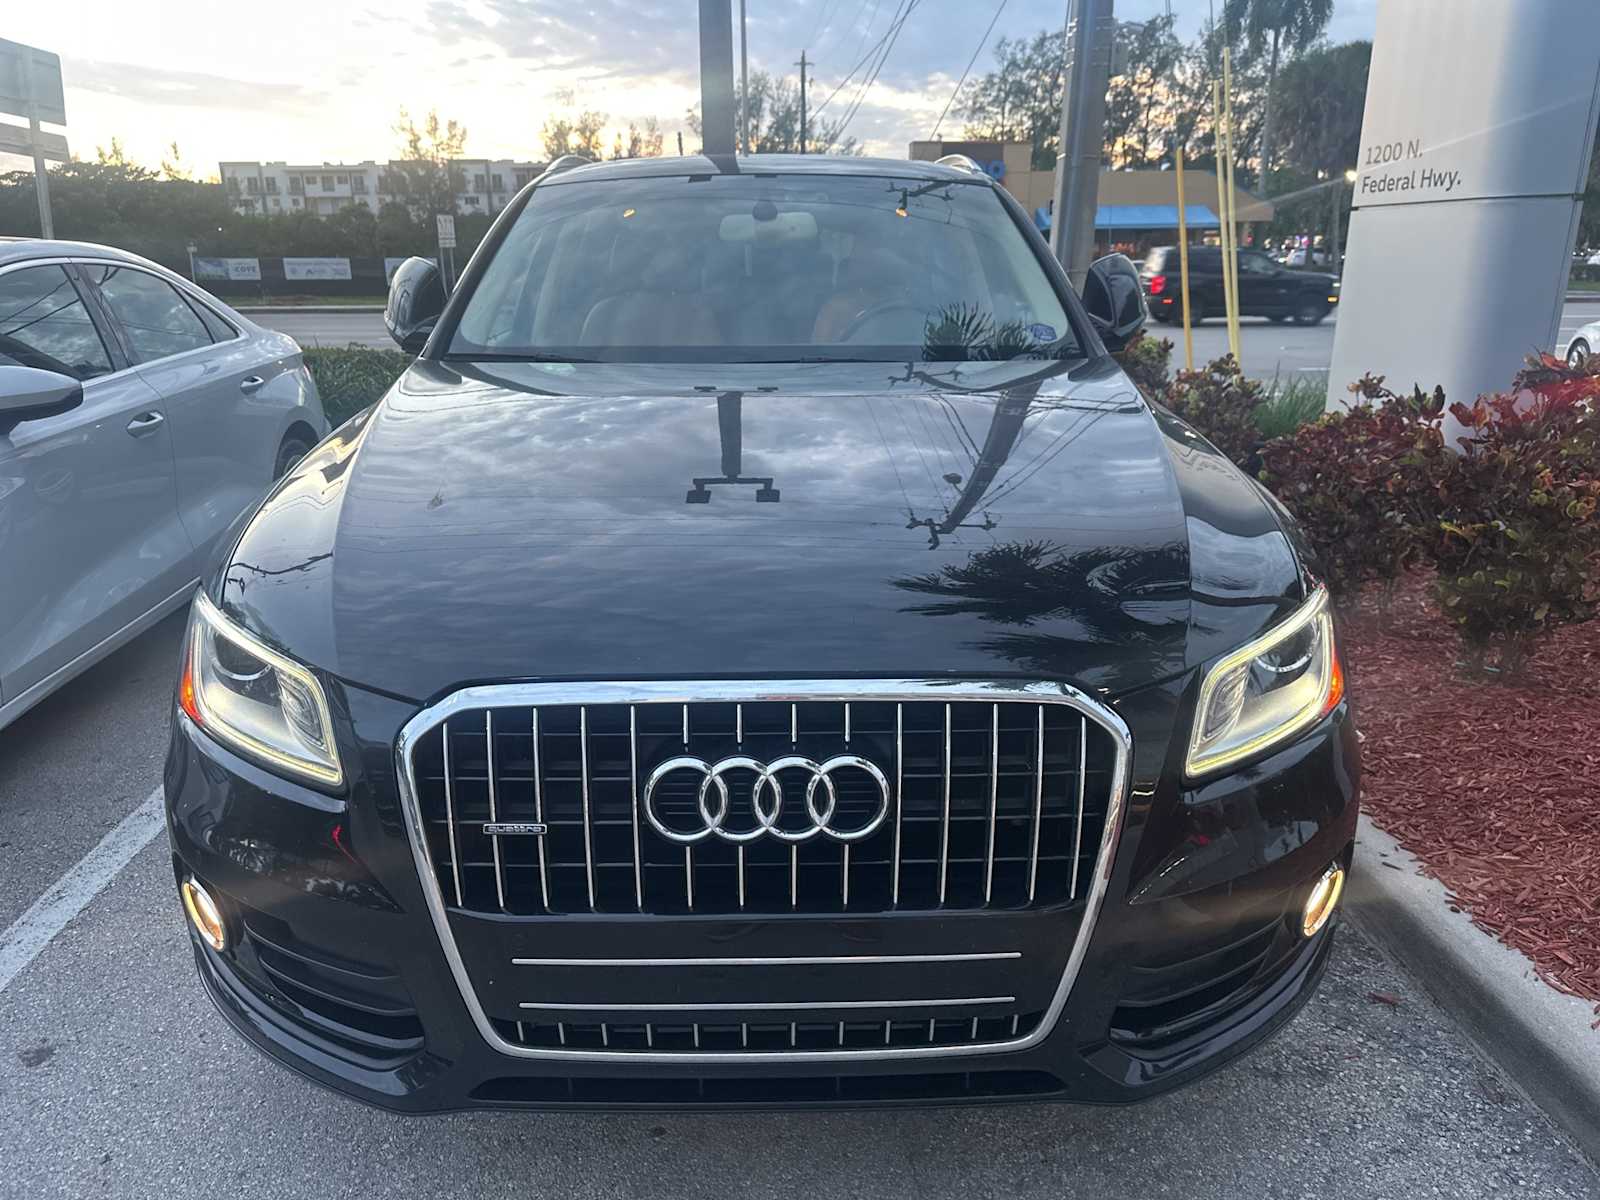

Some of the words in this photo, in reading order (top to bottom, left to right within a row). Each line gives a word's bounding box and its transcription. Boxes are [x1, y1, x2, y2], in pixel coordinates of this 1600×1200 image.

[1365, 141, 1402, 165] 1200
[1407, 138, 1423, 159] N.
[1361, 170, 1415, 194] Federal
[1420, 167, 1461, 192] Hwy.
[487, 825, 543, 833] quattro
